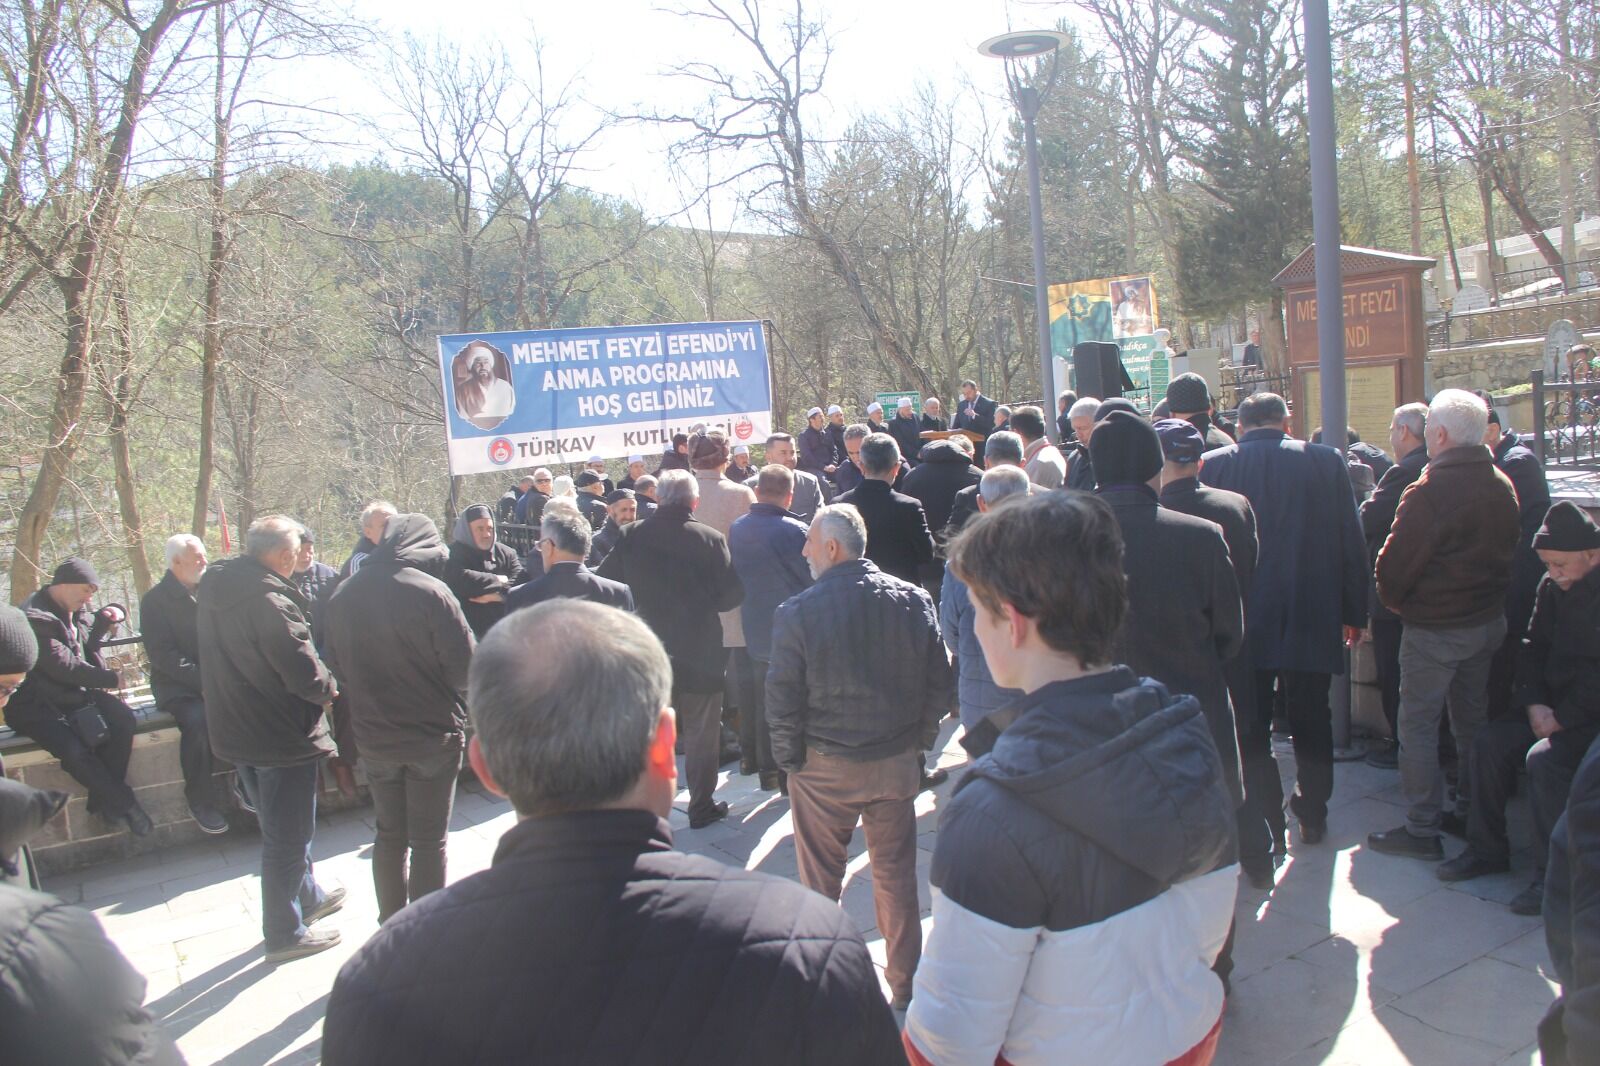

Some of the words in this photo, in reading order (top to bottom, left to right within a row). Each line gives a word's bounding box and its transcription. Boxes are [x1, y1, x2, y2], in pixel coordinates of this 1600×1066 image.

[1296, 294, 1356, 322] MEET
[1360, 284, 1397, 315] FEYZİ
[512, 339, 600, 364] MEHMET
[606, 332, 663, 359] FEYZİ
[542, 368, 605, 392] ANMA
[611, 359, 740, 385] PROGRAMINA
[579, 394, 623, 418] HOŞ
[627, 383, 715, 412] GELDİNİZ
[517, 435, 596, 458] TÜRKAV
